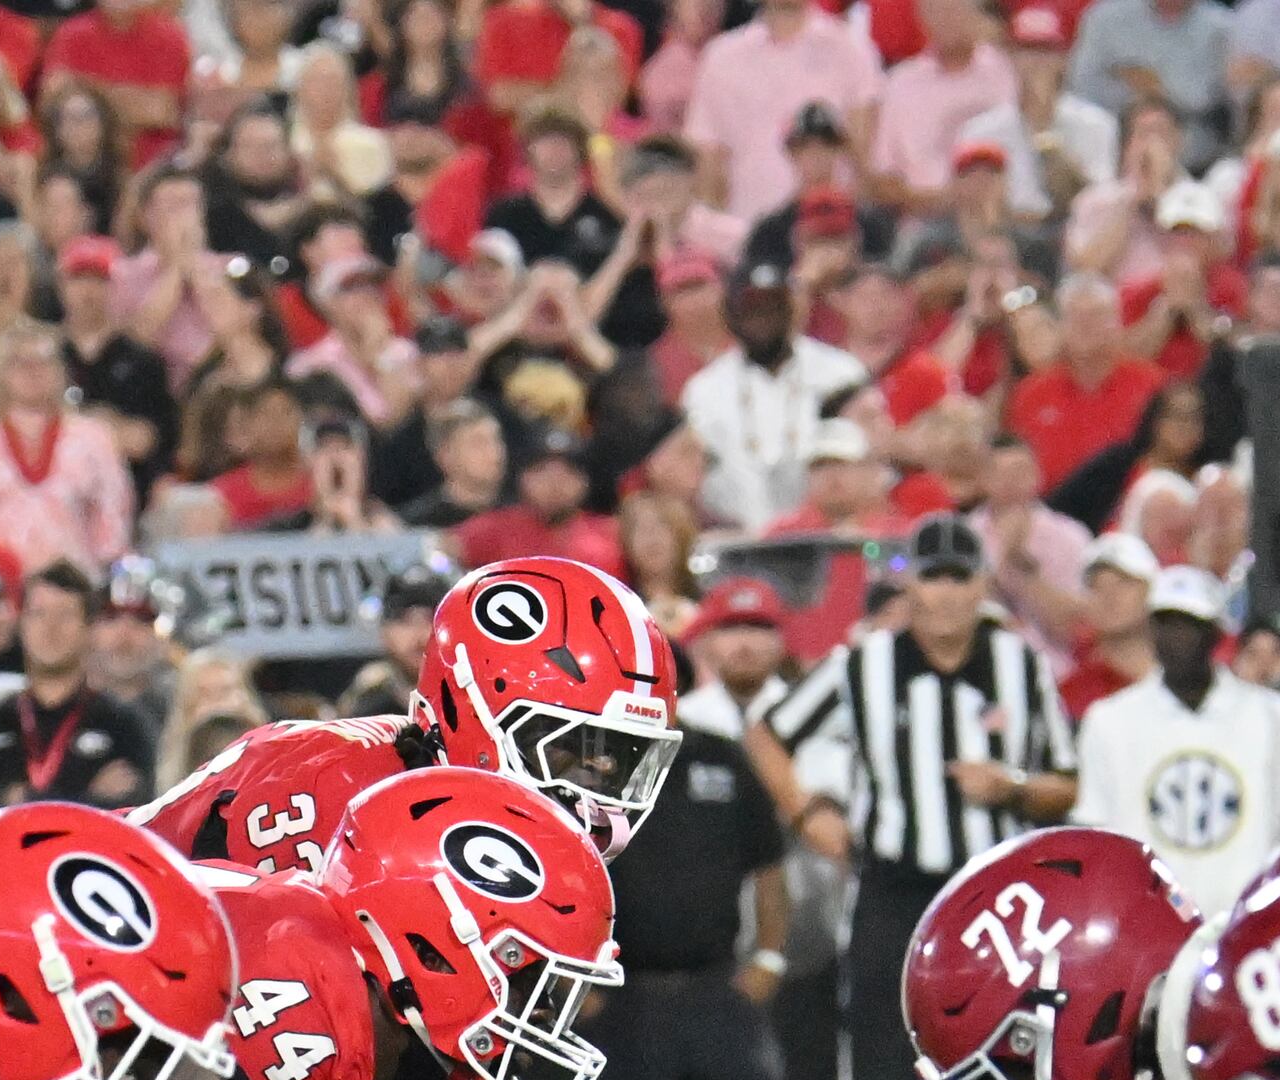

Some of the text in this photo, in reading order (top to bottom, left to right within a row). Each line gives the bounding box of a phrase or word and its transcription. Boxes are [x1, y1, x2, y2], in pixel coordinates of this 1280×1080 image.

[473, 582, 547, 644] G
[625, 703, 663, 719] DAWGS
[441, 822, 544, 902] G
[49, 853, 157, 952] G
[960, 881, 1072, 988] 72
